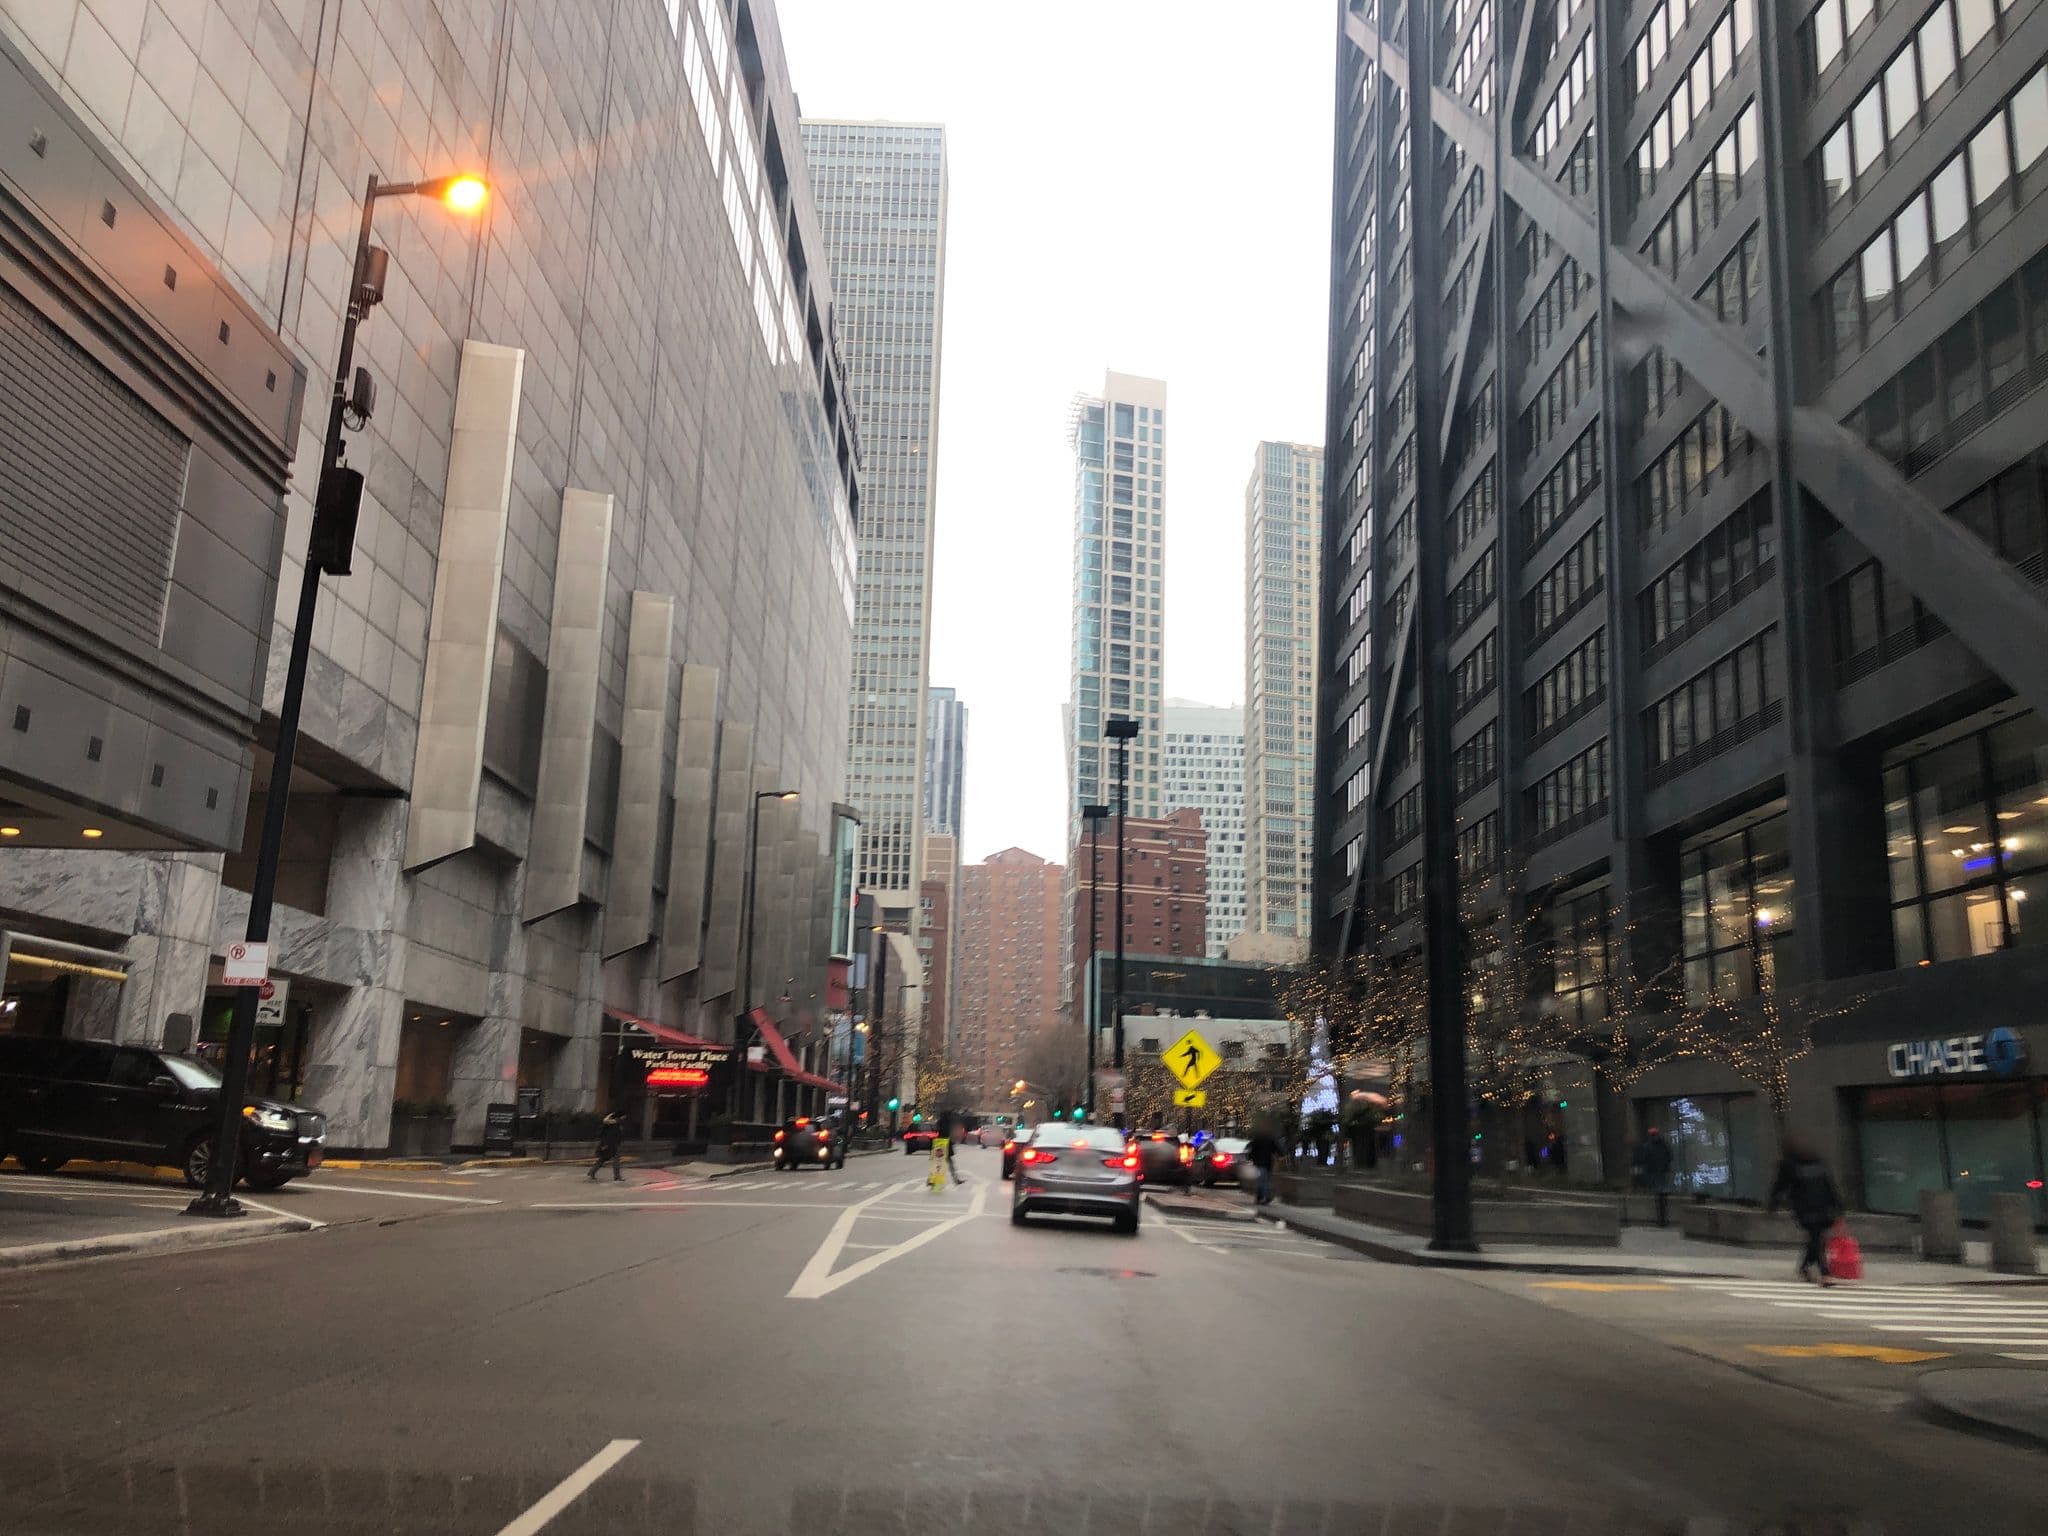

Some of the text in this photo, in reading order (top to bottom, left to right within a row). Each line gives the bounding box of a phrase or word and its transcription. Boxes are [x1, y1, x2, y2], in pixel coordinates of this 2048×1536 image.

[632, 1049, 729, 1062] Water Tower Place
[1887, 1034, 1987, 1077] CHASE
[645, 1060, 713, 1071] Parking Facility
